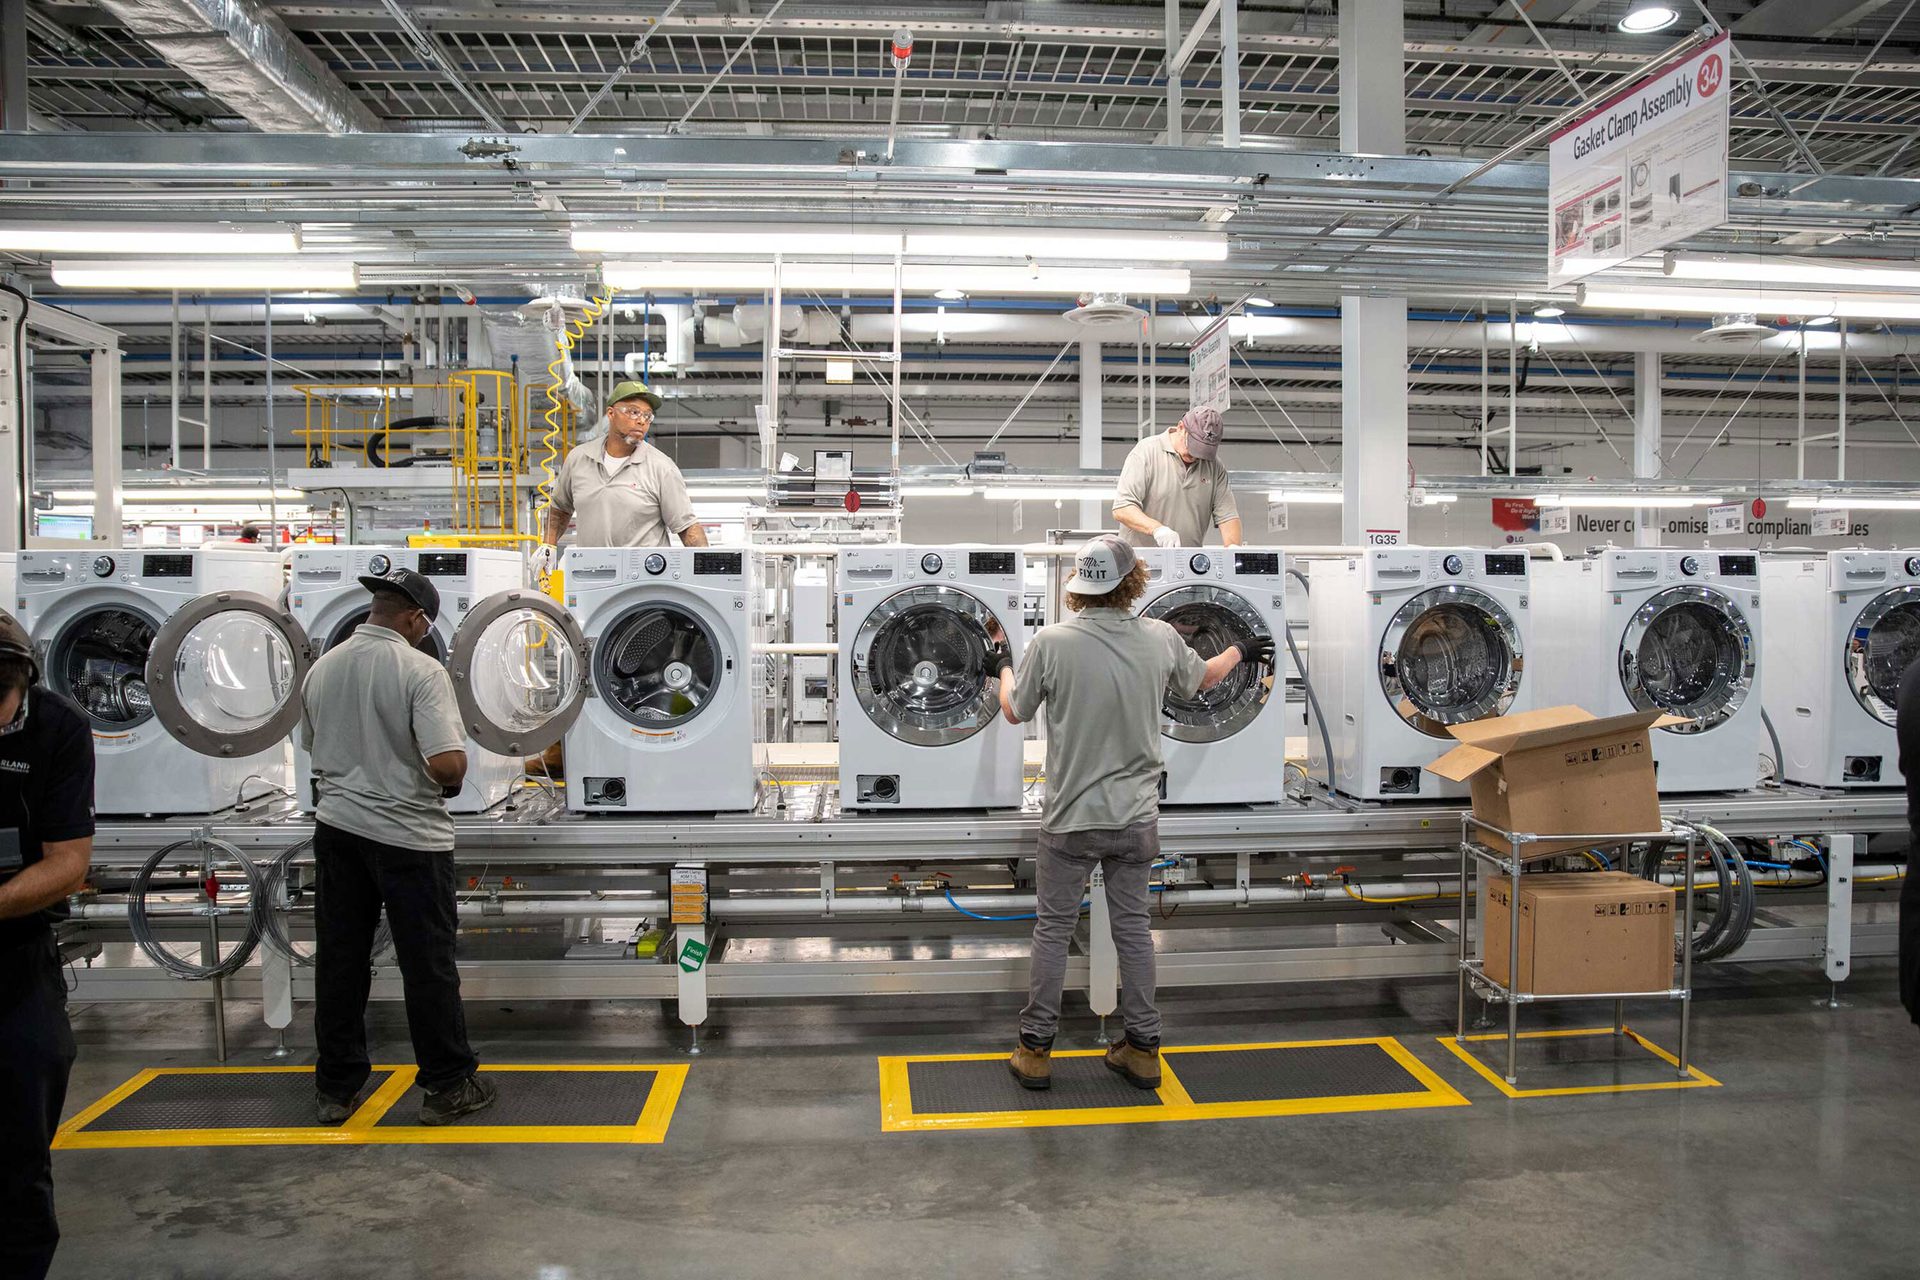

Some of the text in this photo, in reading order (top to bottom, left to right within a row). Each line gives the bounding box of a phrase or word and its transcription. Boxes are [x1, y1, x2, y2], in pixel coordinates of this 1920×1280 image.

[1701, 60, 1719, 92] 34
[1574, 127, 1605, 159] Gasket
[1608, 110, 1637, 141] Clamp
[1641, 74, 1692, 124] Assembly
[1577, 514, 1619, 532] Never
[1369, 535, 1397, 545] 1G35
[1083, 557, 1100, 569] Mr.
[1080, 568, 1106, 579] FIX IT
[686, 946, 703, 957] Finish
